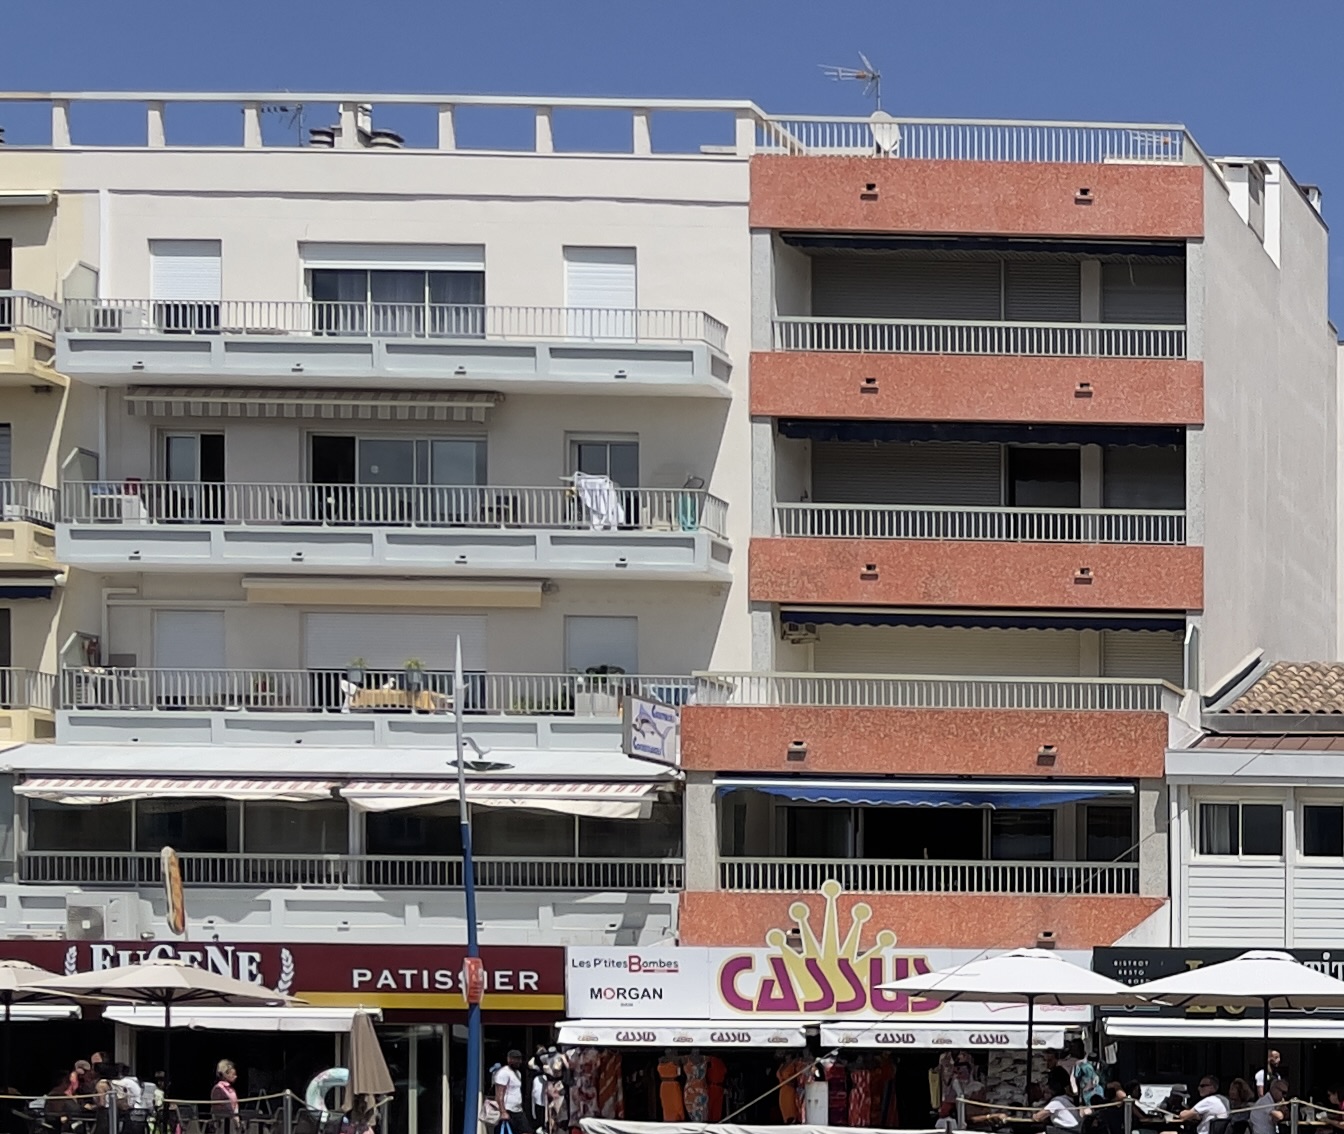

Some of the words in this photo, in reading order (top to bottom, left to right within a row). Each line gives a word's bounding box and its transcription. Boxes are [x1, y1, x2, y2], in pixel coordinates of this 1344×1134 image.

[572, 958, 591, 968] Les
[628, 955, 679, 973] Bombes
[590, 987, 663, 1000] MORGAN
[616, 1031, 657, 1042] CASSUS
[710, 1032, 751, 1043] CASSUS
[875, 1033, 916, 1044] CASSUS
[968, 1033, 1010, 1045] CASSUS
